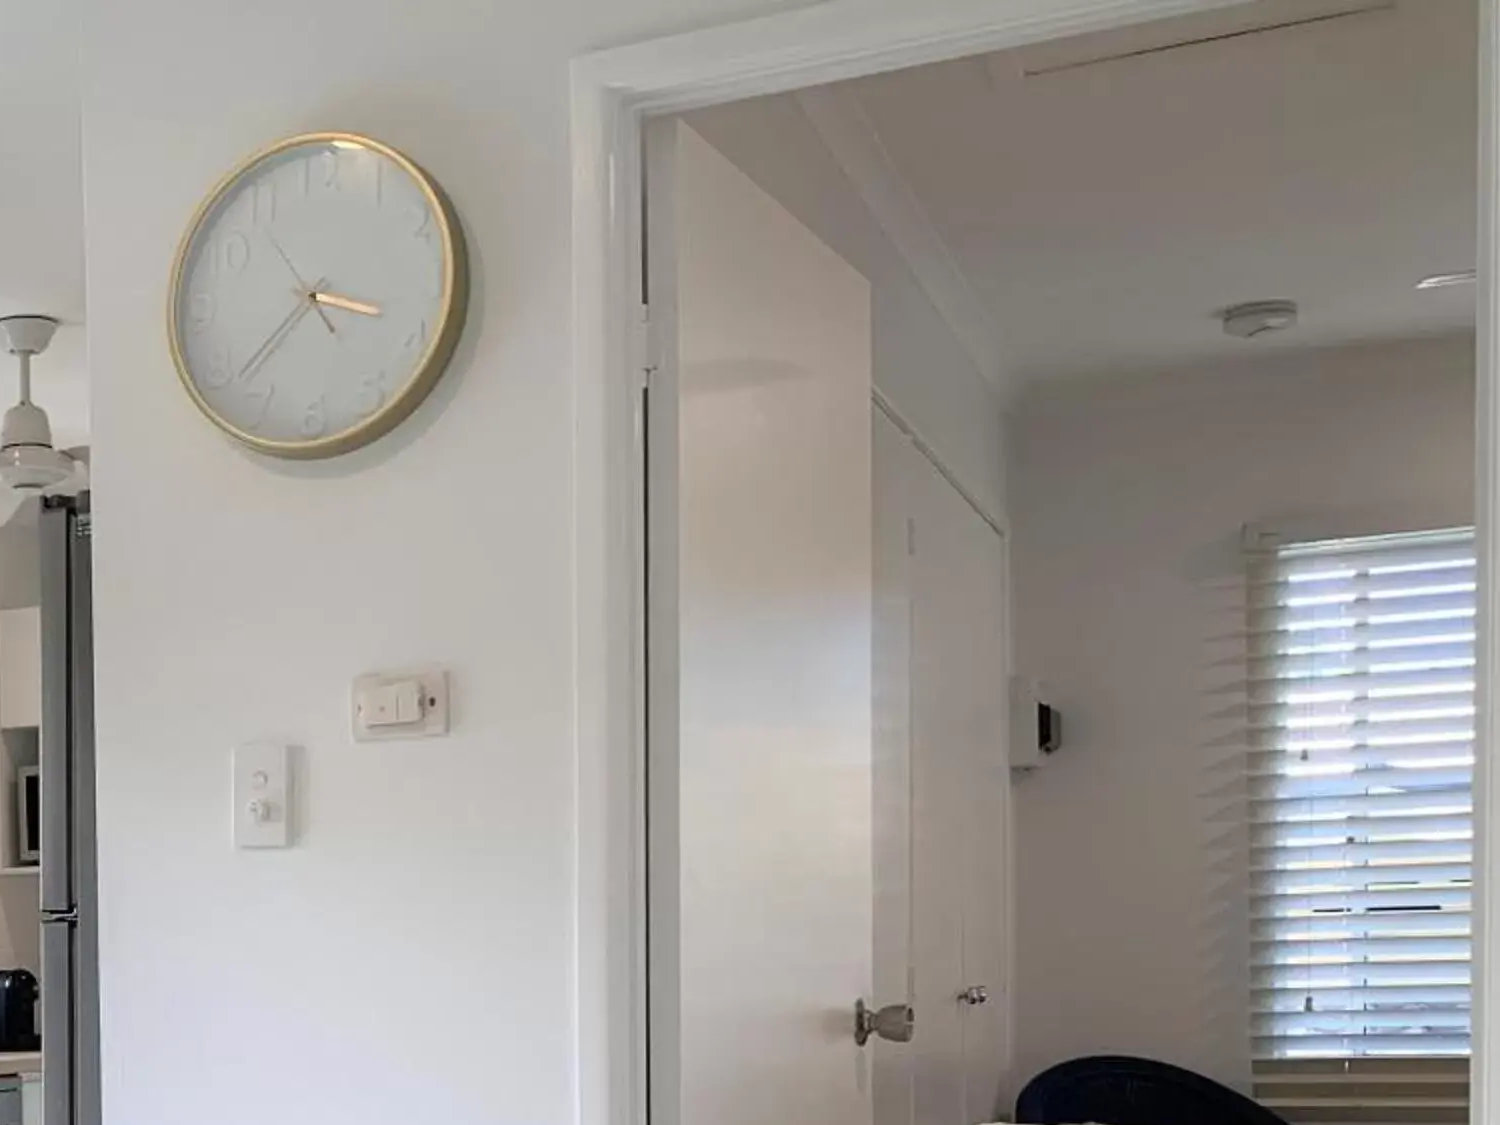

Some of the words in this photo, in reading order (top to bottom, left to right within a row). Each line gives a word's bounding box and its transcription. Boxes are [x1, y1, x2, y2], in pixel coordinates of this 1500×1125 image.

[251, 183, 277, 225] 11
[403, 206, 431, 244] 2
[209, 229, 251, 279] 10
[244, 384, 276, 431] 7
